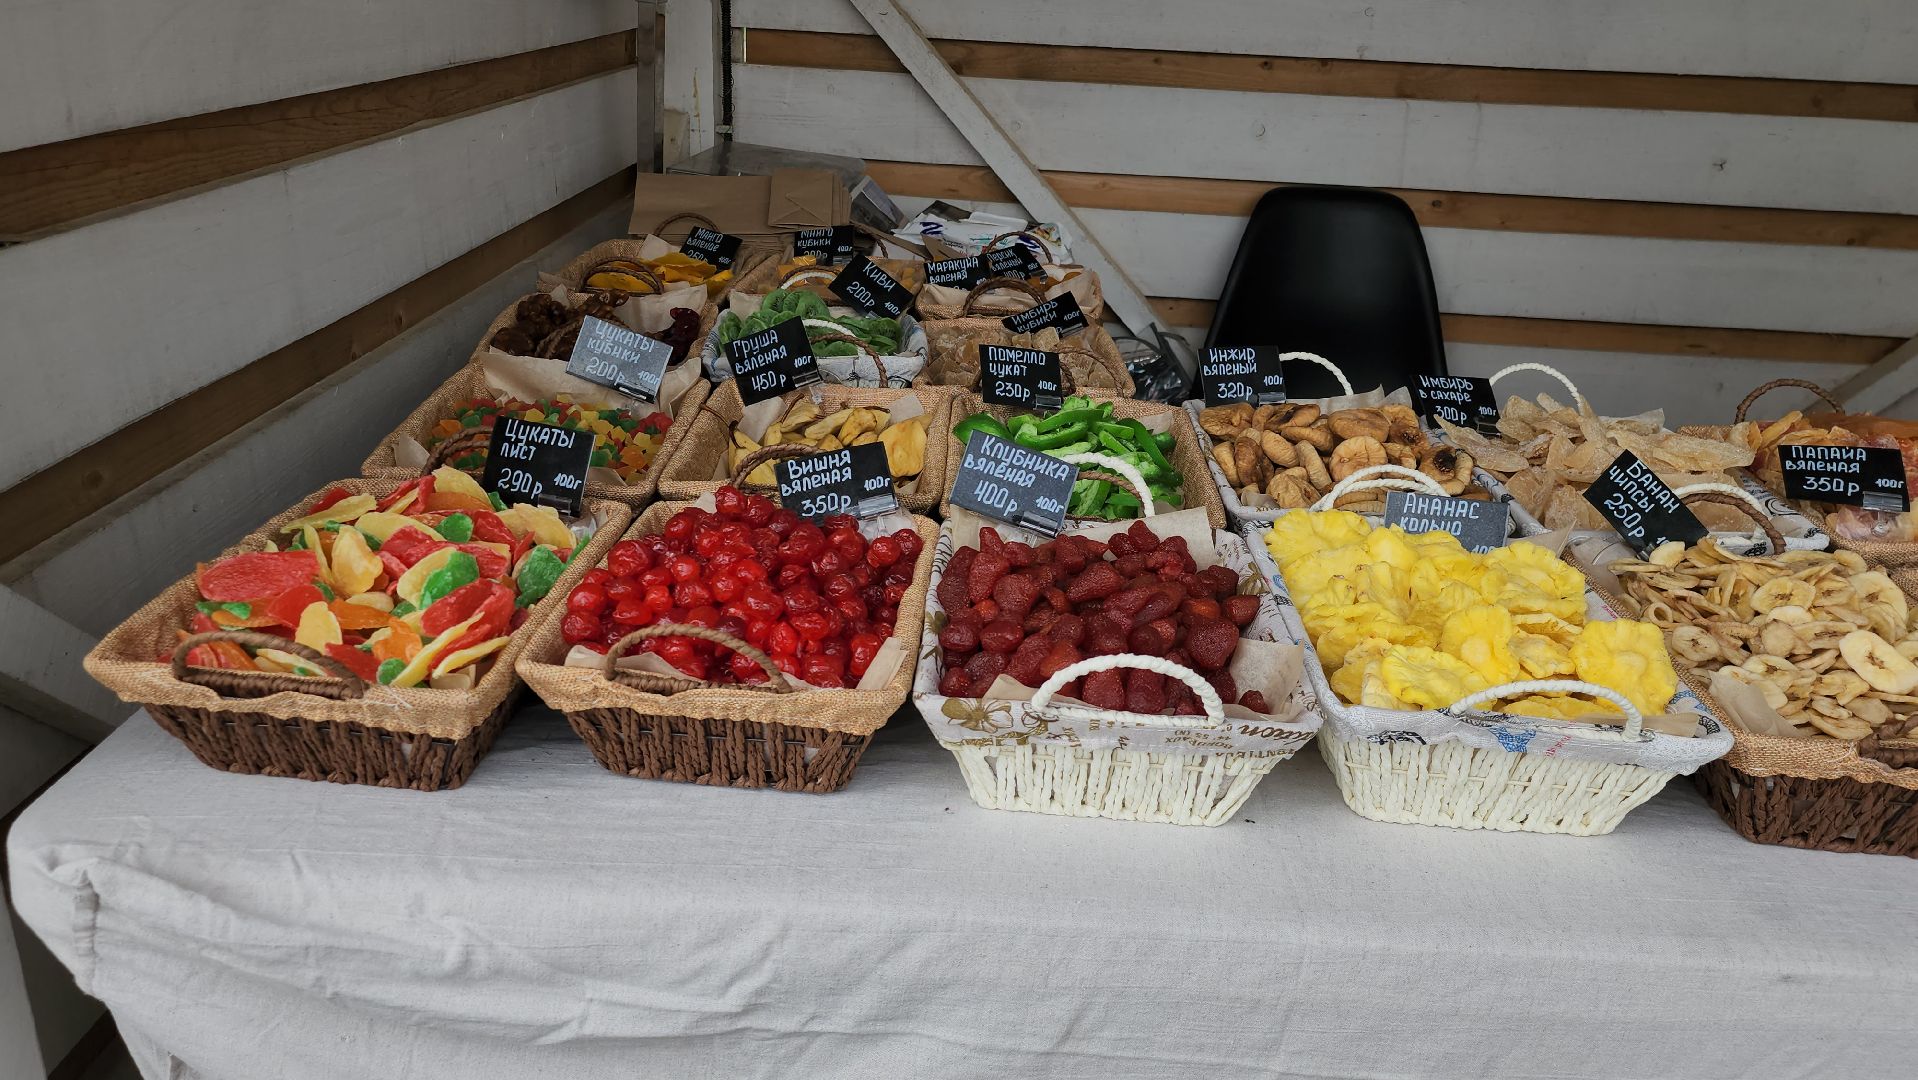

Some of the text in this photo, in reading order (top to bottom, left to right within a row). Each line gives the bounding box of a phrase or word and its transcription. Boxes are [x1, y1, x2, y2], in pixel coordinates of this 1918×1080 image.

[797, 238, 831, 248] КУБИКИ
[862, 261, 896, 292] КИВИ
[884, 301, 901, 316] 100г
[1011, 301, 1058, 325] ИМБИРЬ
[1063, 311, 1080, 321] 100г
[1017, 310, 1057, 333] КУБИКИ
[596, 320, 655, 353] ЦУКАТЫ
[732, 330, 778, 358] ГРУША
[586, 338, 641, 364] КУБИКИ
[988, 346, 1046, 366] ПОМЕЛЛО
[1209, 348, 1256, 364] ИНЖИР
[794, 356, 812, 368] 100г
[989, 362, 1028, 378] ЦУКАТ
[1203, 360, 1257, 376] ВЯЛЕНЫЙ
[1038, 380, 1058, 391] 100г
[1264, 375, 1284, 386] 100г
[1418, 374, 1474, 392] ИМБИРЬ
[1430, 391, 1472, 406] САХАРЕ
[1478, 406, 1496, 416] 100г
[505, 418, 576, 449] ЦУКАТЫ
[500, 442, 537, 460] ЛИСТ
[980, 435, 1070, 482] КЛУБНИКА
[787, 450, 852, 480] ВИШНЯ
[554, 472, 582, 490] 100г
[864, 476, 891, 492] 100г
[1608, 465, 1656, 513] ЧИПСЫ
[1626, 460, 1680, 514] БАНАН
[1874, 478, 1904, 489] 100г
[1036, 496, 1065, 514] 100г
[1403, 492, 1480, 520] АНАНАС
